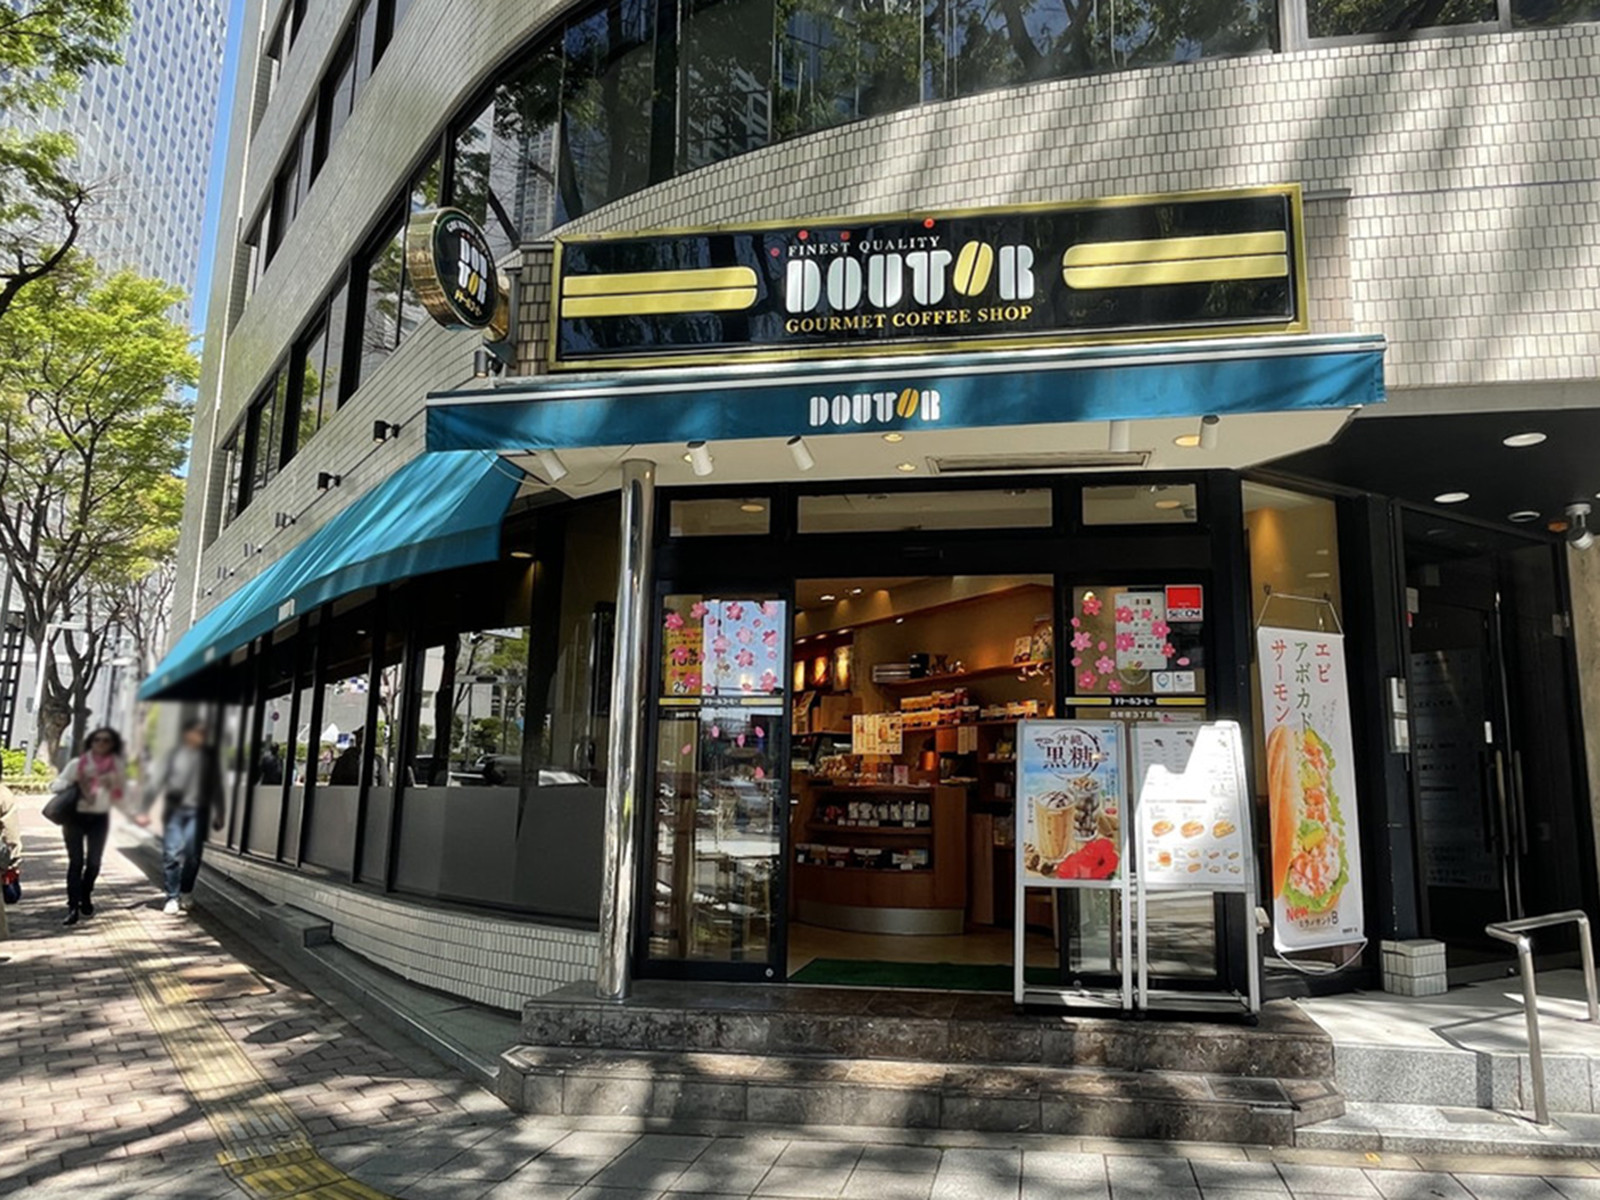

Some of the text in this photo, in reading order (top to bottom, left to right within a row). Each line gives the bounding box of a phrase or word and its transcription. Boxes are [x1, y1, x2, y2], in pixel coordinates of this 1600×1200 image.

[788, 235, 941, 257] FINEST QUALITY
[786, 240, 1035, 313] DOUTOR
[786, 305, 1033, 333] GOURMET COFFEE SHOP
[809, 388, 941, 427] DOUTOR
[1271, 639, 1290, 722] サーモン
[1316, 643, 1331, 683] エビ
[1295, 641, 1313, 733] アボカド
[1043, 745, 1096, 770] 黒糖
